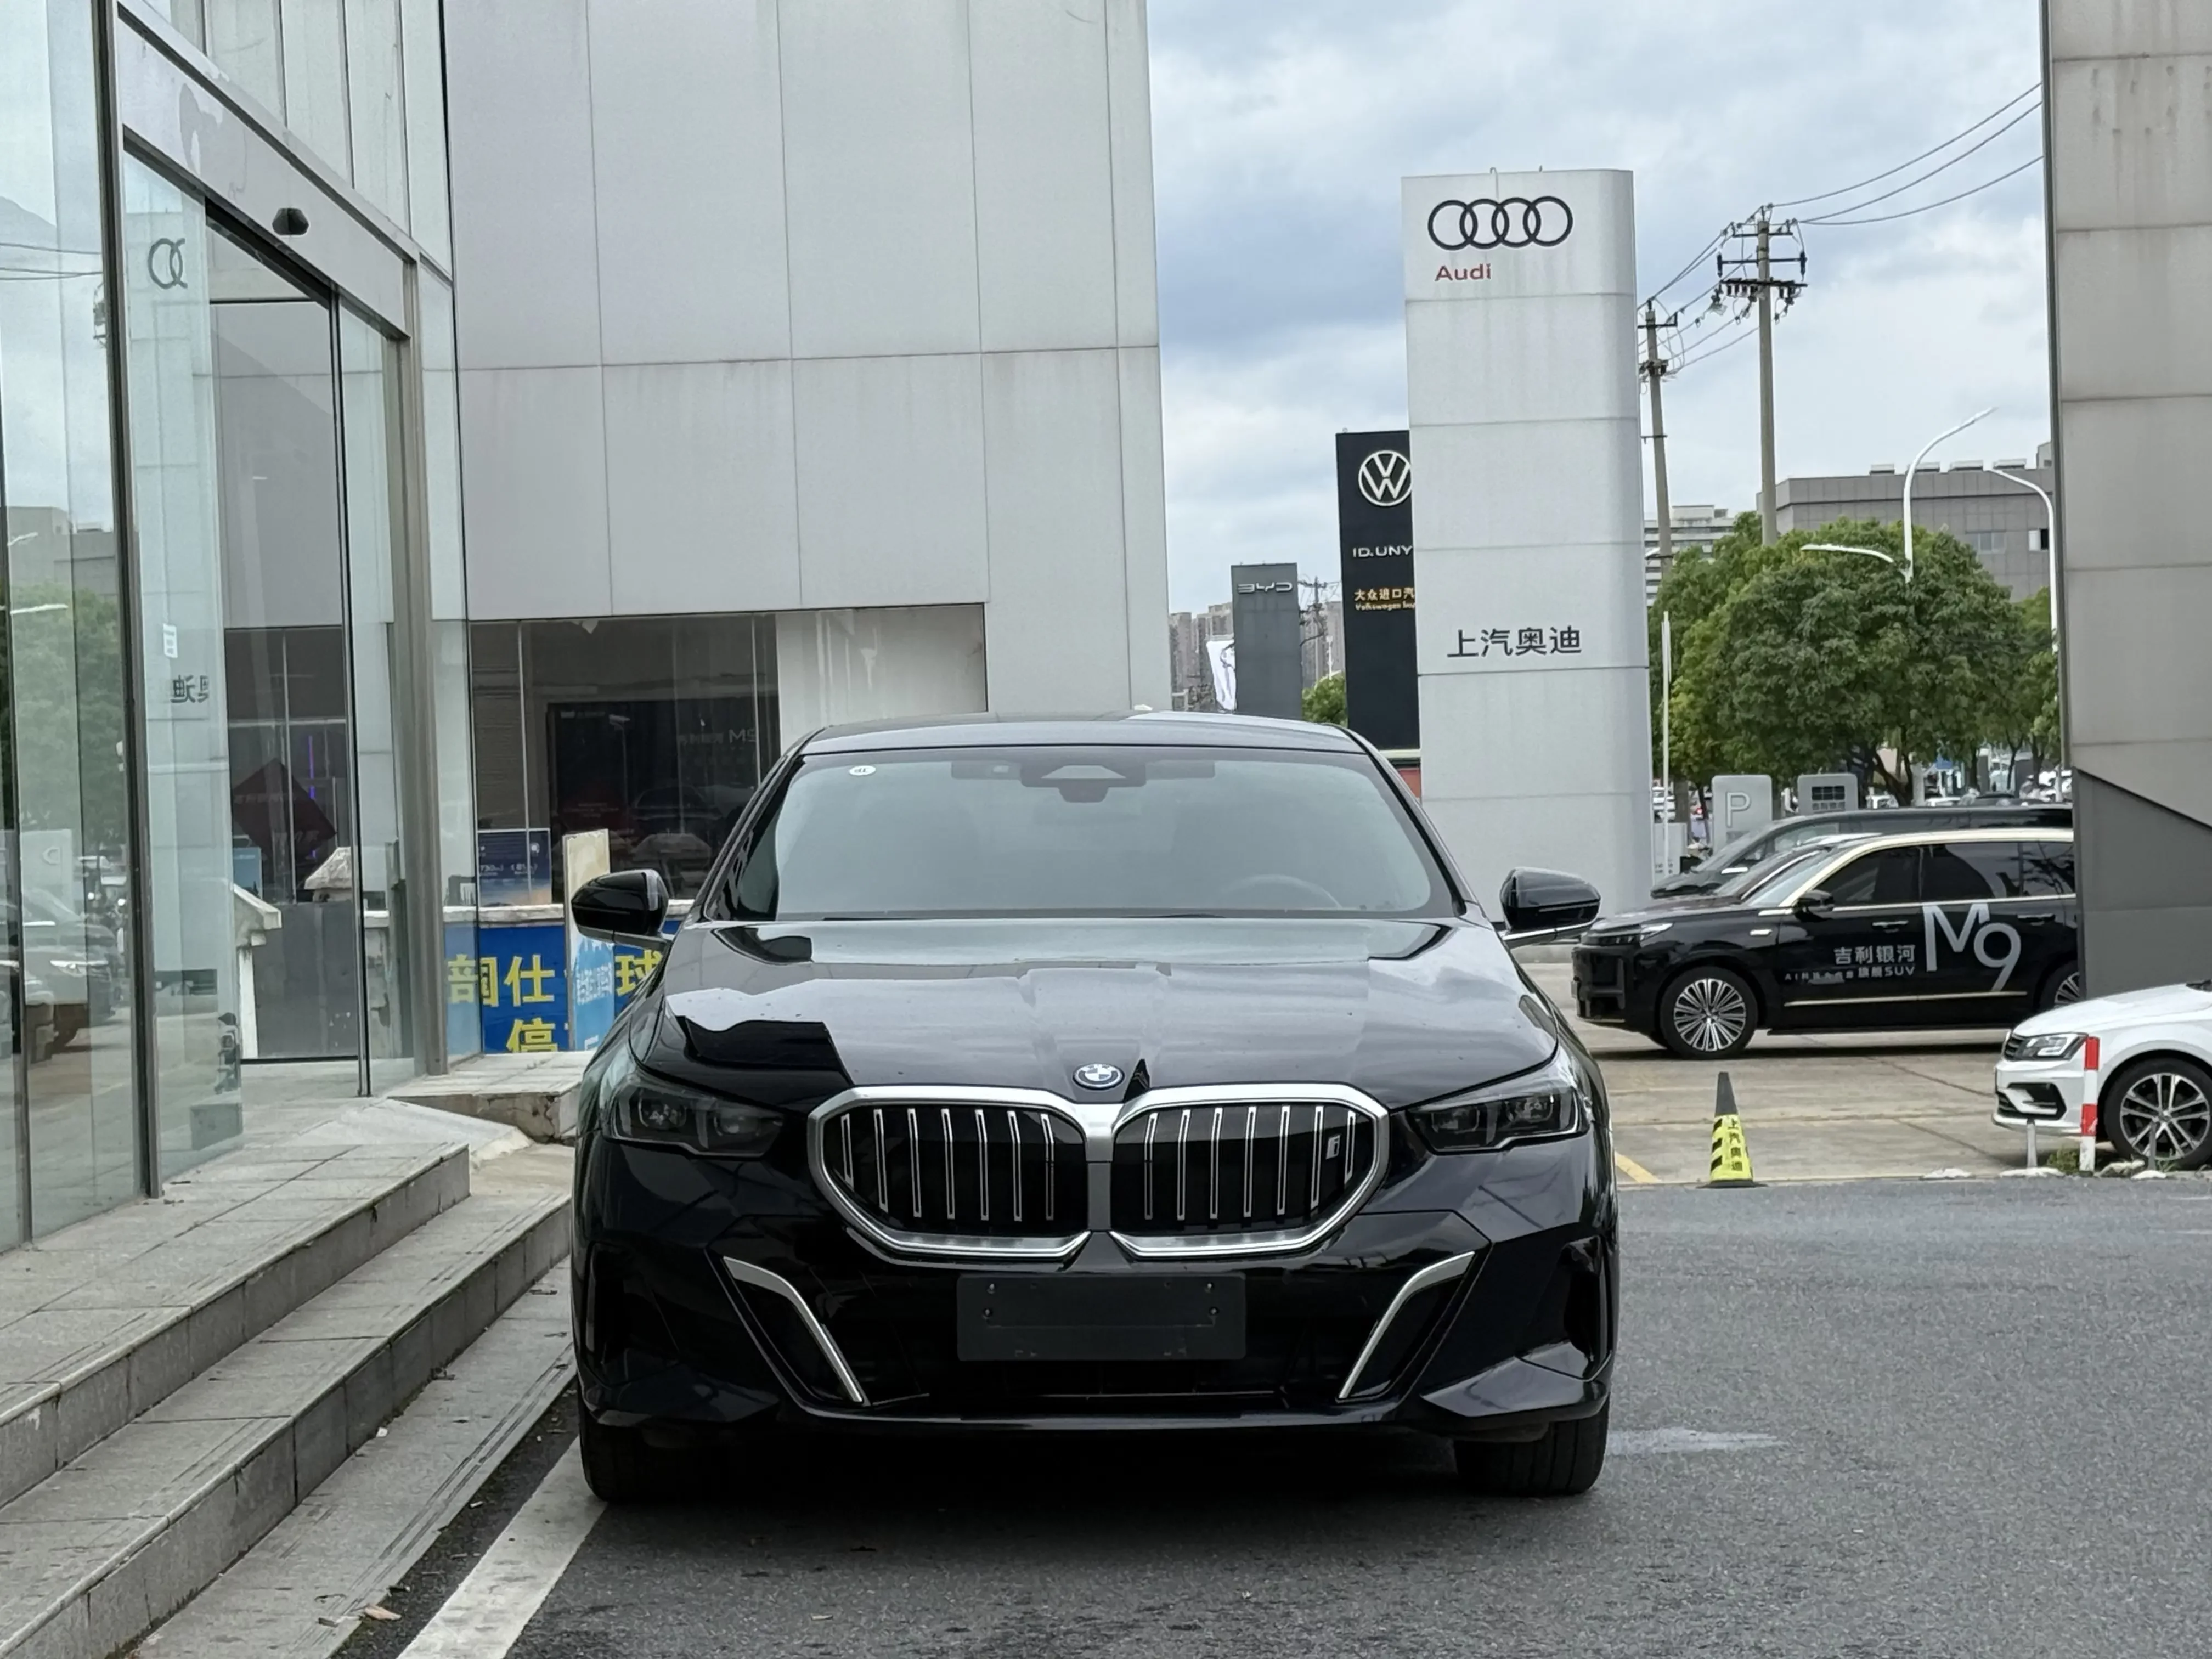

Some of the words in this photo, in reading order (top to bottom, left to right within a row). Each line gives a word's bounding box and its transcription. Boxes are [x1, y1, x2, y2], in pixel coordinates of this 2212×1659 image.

[1435, 263, 1491, 282] Audi
[1238, 582, 1293, 593] BYD
[1446, 625, 1582, 659] 上汽奥迪
[1725, 791, 1752, 828] P
[1833, 944, 1916, 965] 吉利银河
[1922, 904, 2022, 992] M9
